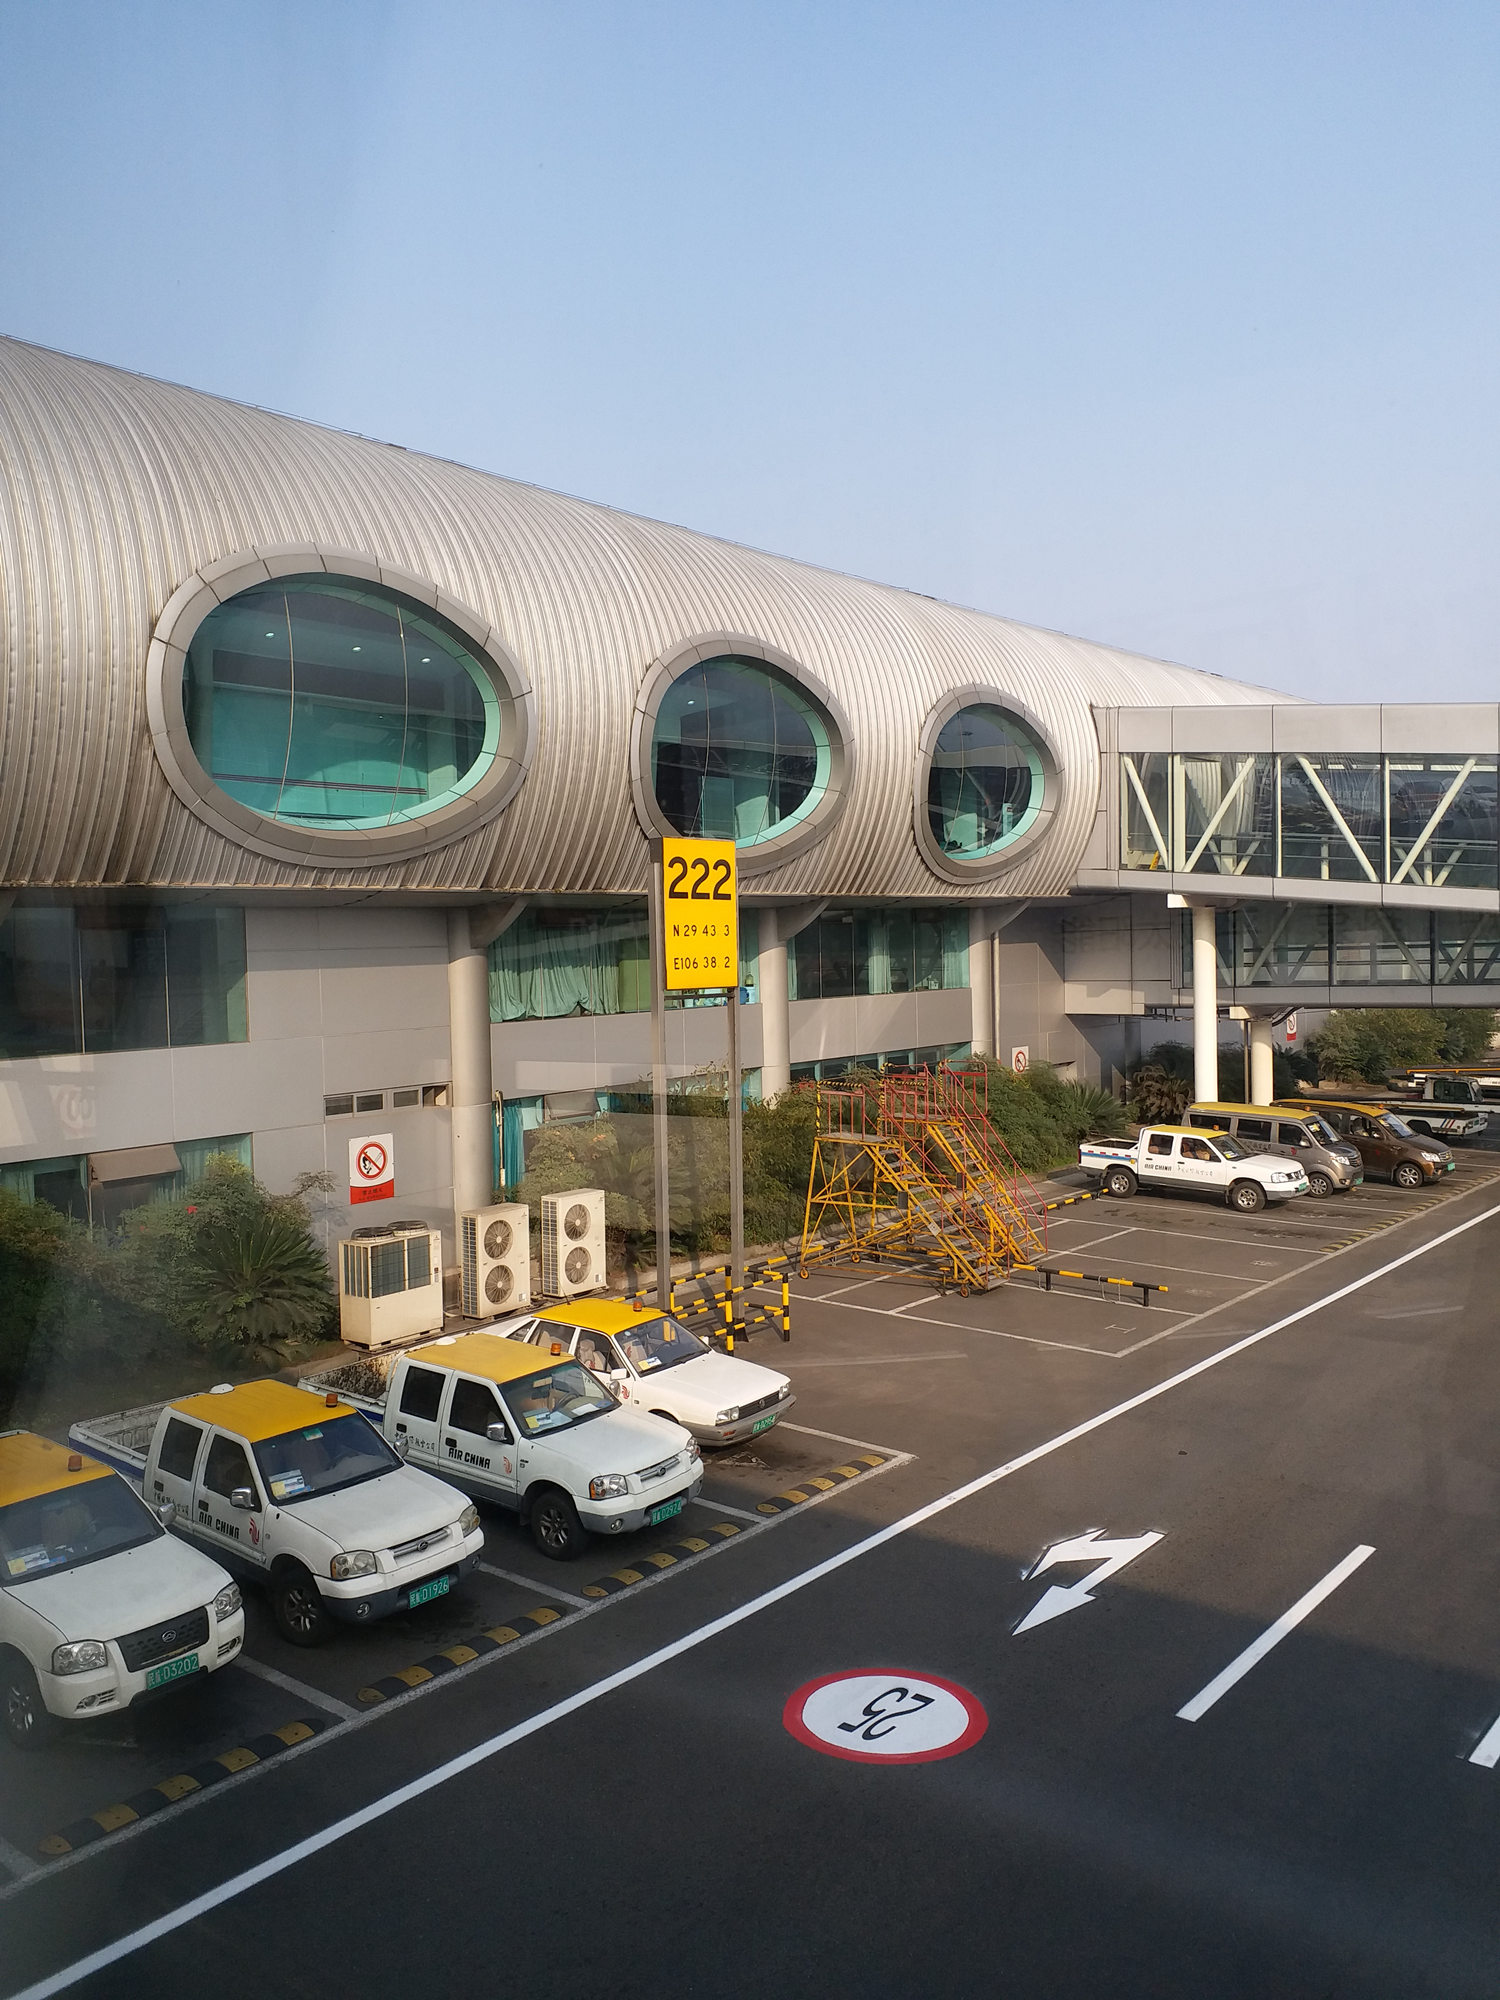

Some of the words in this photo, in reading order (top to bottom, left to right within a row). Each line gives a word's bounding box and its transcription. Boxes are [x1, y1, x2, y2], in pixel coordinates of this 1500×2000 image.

[667, 856, 732, 901] 222
[673, 924, 680, 937] N
[683, 924, 698, 937] 29
[702, 924, 717, 937] 43
[723, 924, 730, 937] 3
[674, 957, 699, 970] E106
[703, 956, 717, 969] 38
[724, 956, 731, 968] 2
[448, 1447, 463, 1460] AIR
[464, 1452, 491, 1469] CHINA
[199, 1511, 213, 1528] AIR
[215, 1518, 240, 1539] CHINA
[837, 1687, 935, 1741] 25
